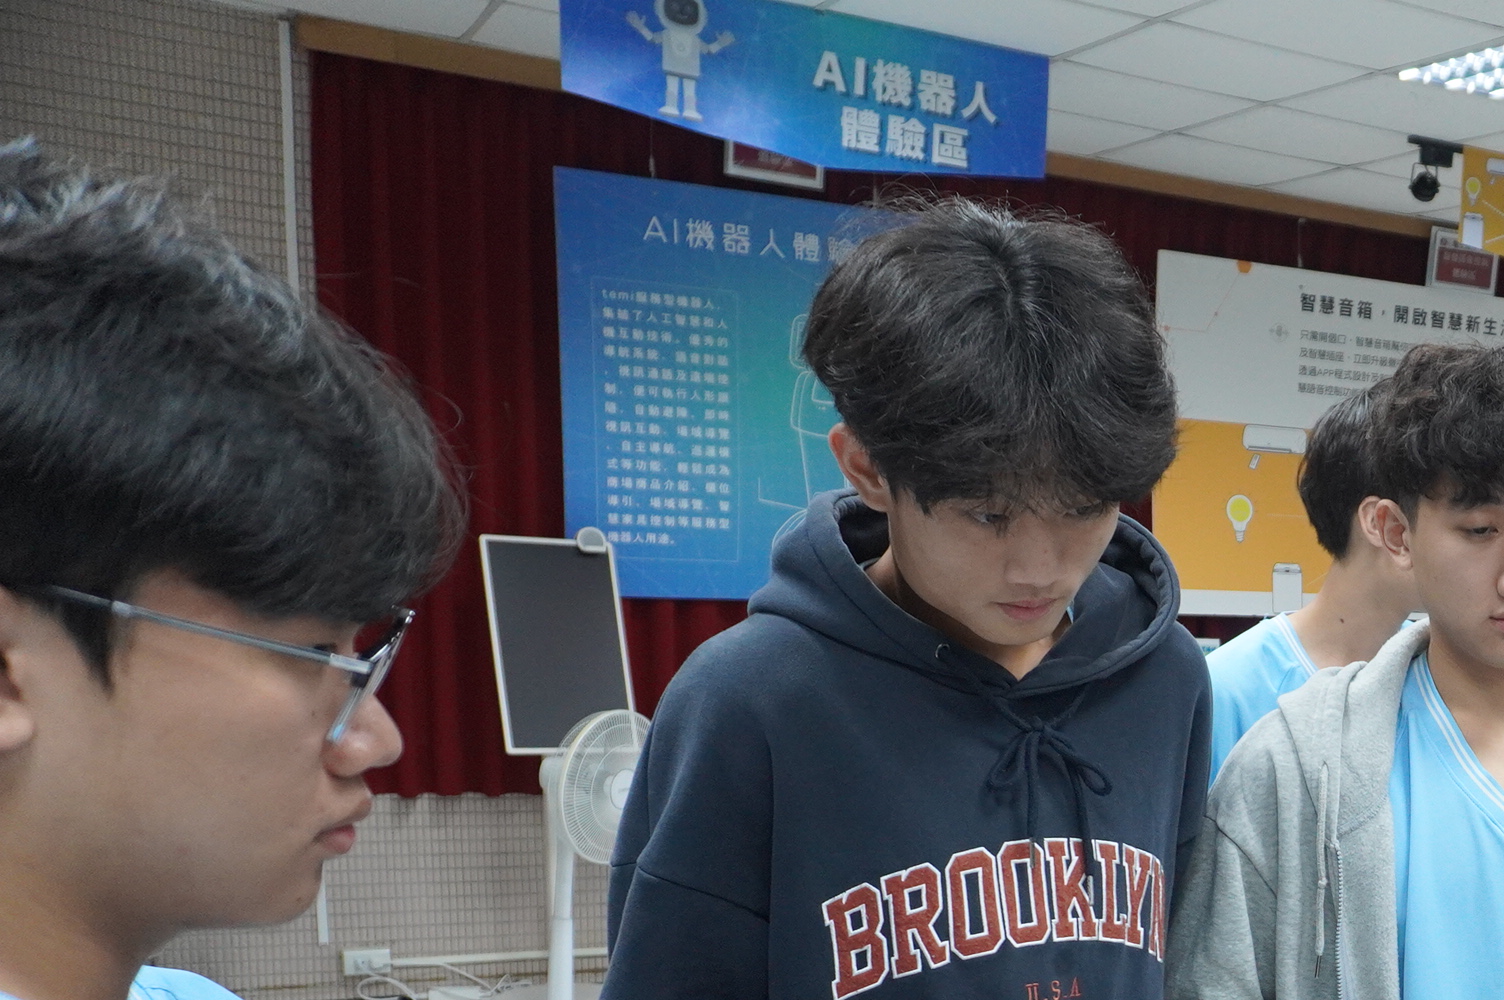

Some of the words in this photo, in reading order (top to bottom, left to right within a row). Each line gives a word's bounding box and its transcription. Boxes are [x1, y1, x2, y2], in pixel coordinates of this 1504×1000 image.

[812, 50, 997, 124] AI機器人
[841, 106, 969, 168] 體驗區
